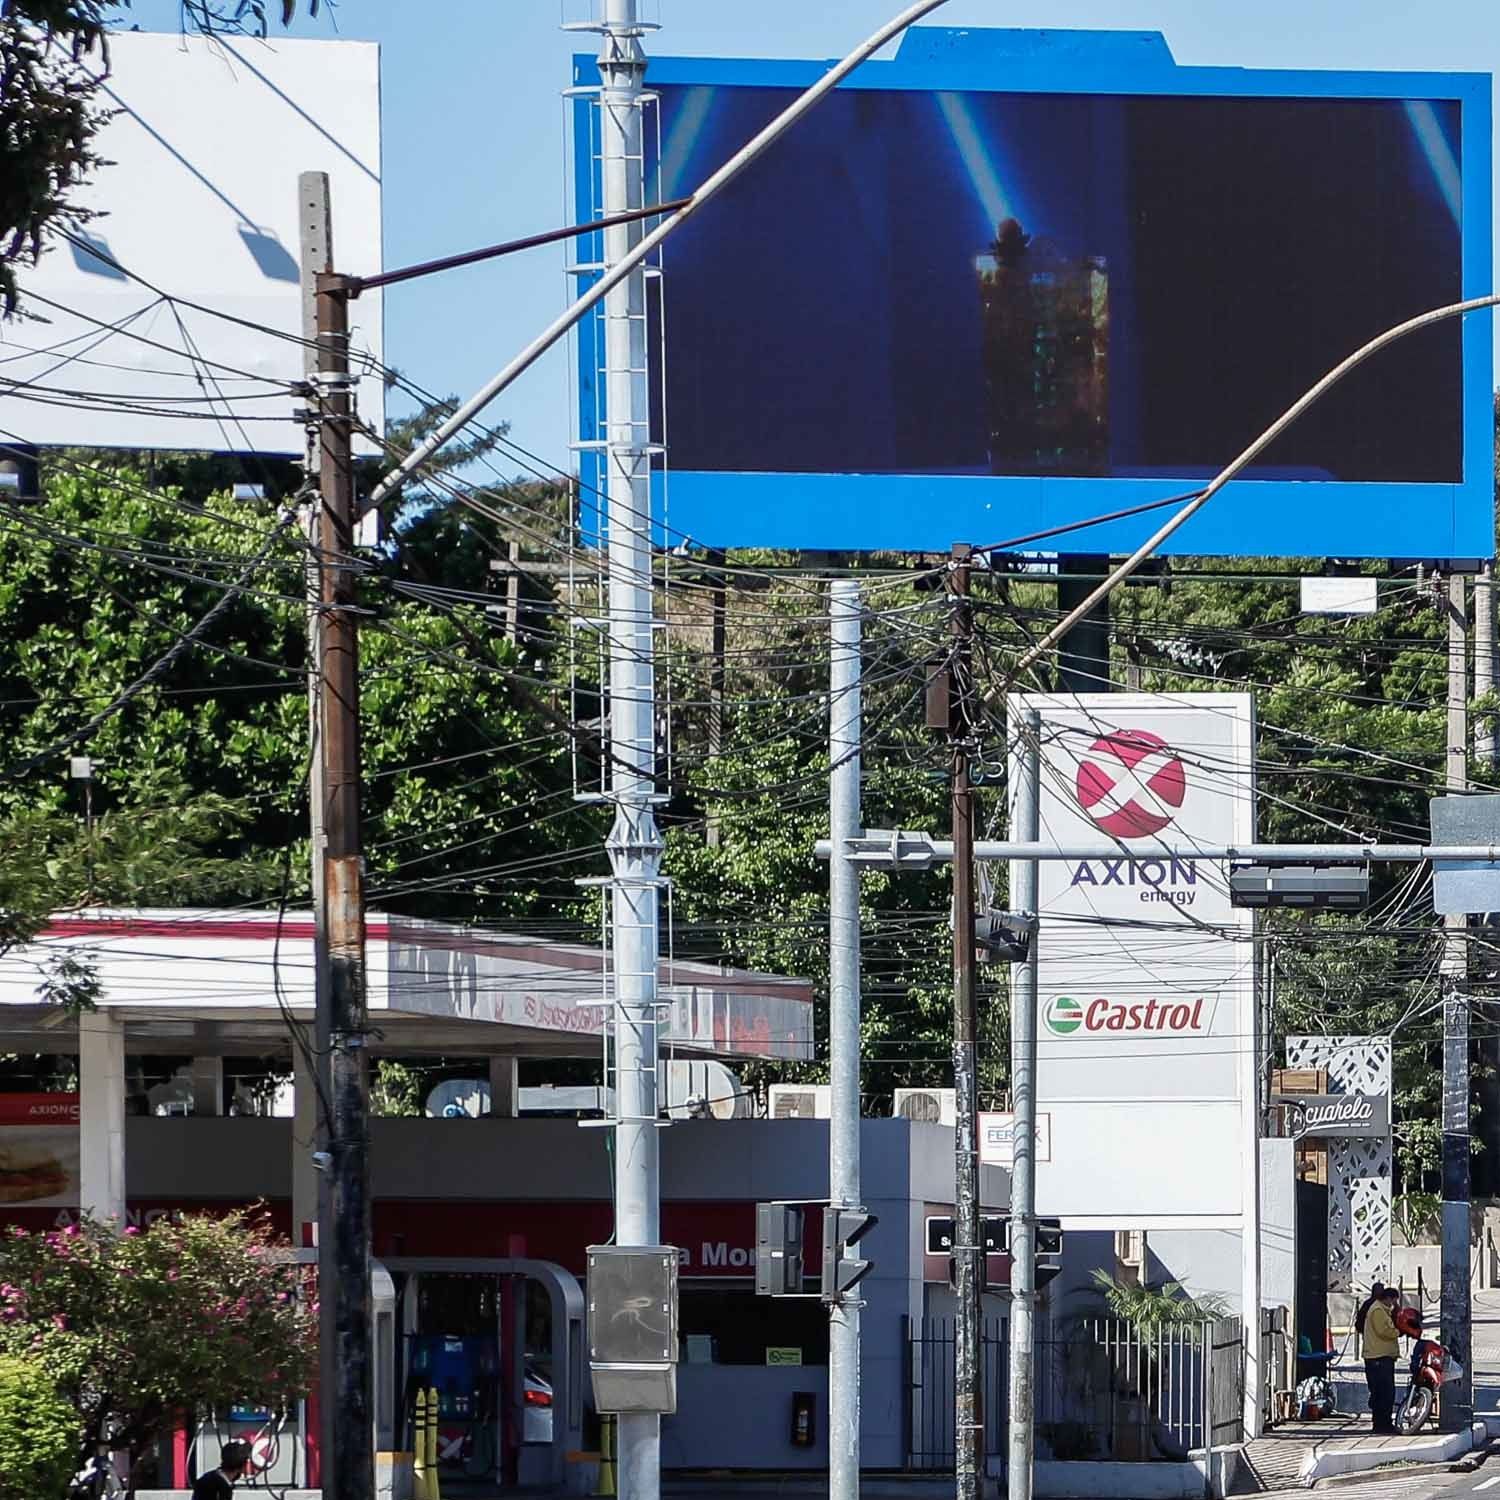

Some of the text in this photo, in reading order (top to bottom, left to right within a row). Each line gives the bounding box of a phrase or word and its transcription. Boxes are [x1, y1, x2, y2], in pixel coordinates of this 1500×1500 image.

[1070, 859, 1197, 886] AXION
[1140, 890, 1196, 905] energy
[1085, 997, 1204, 1031] Castrol
